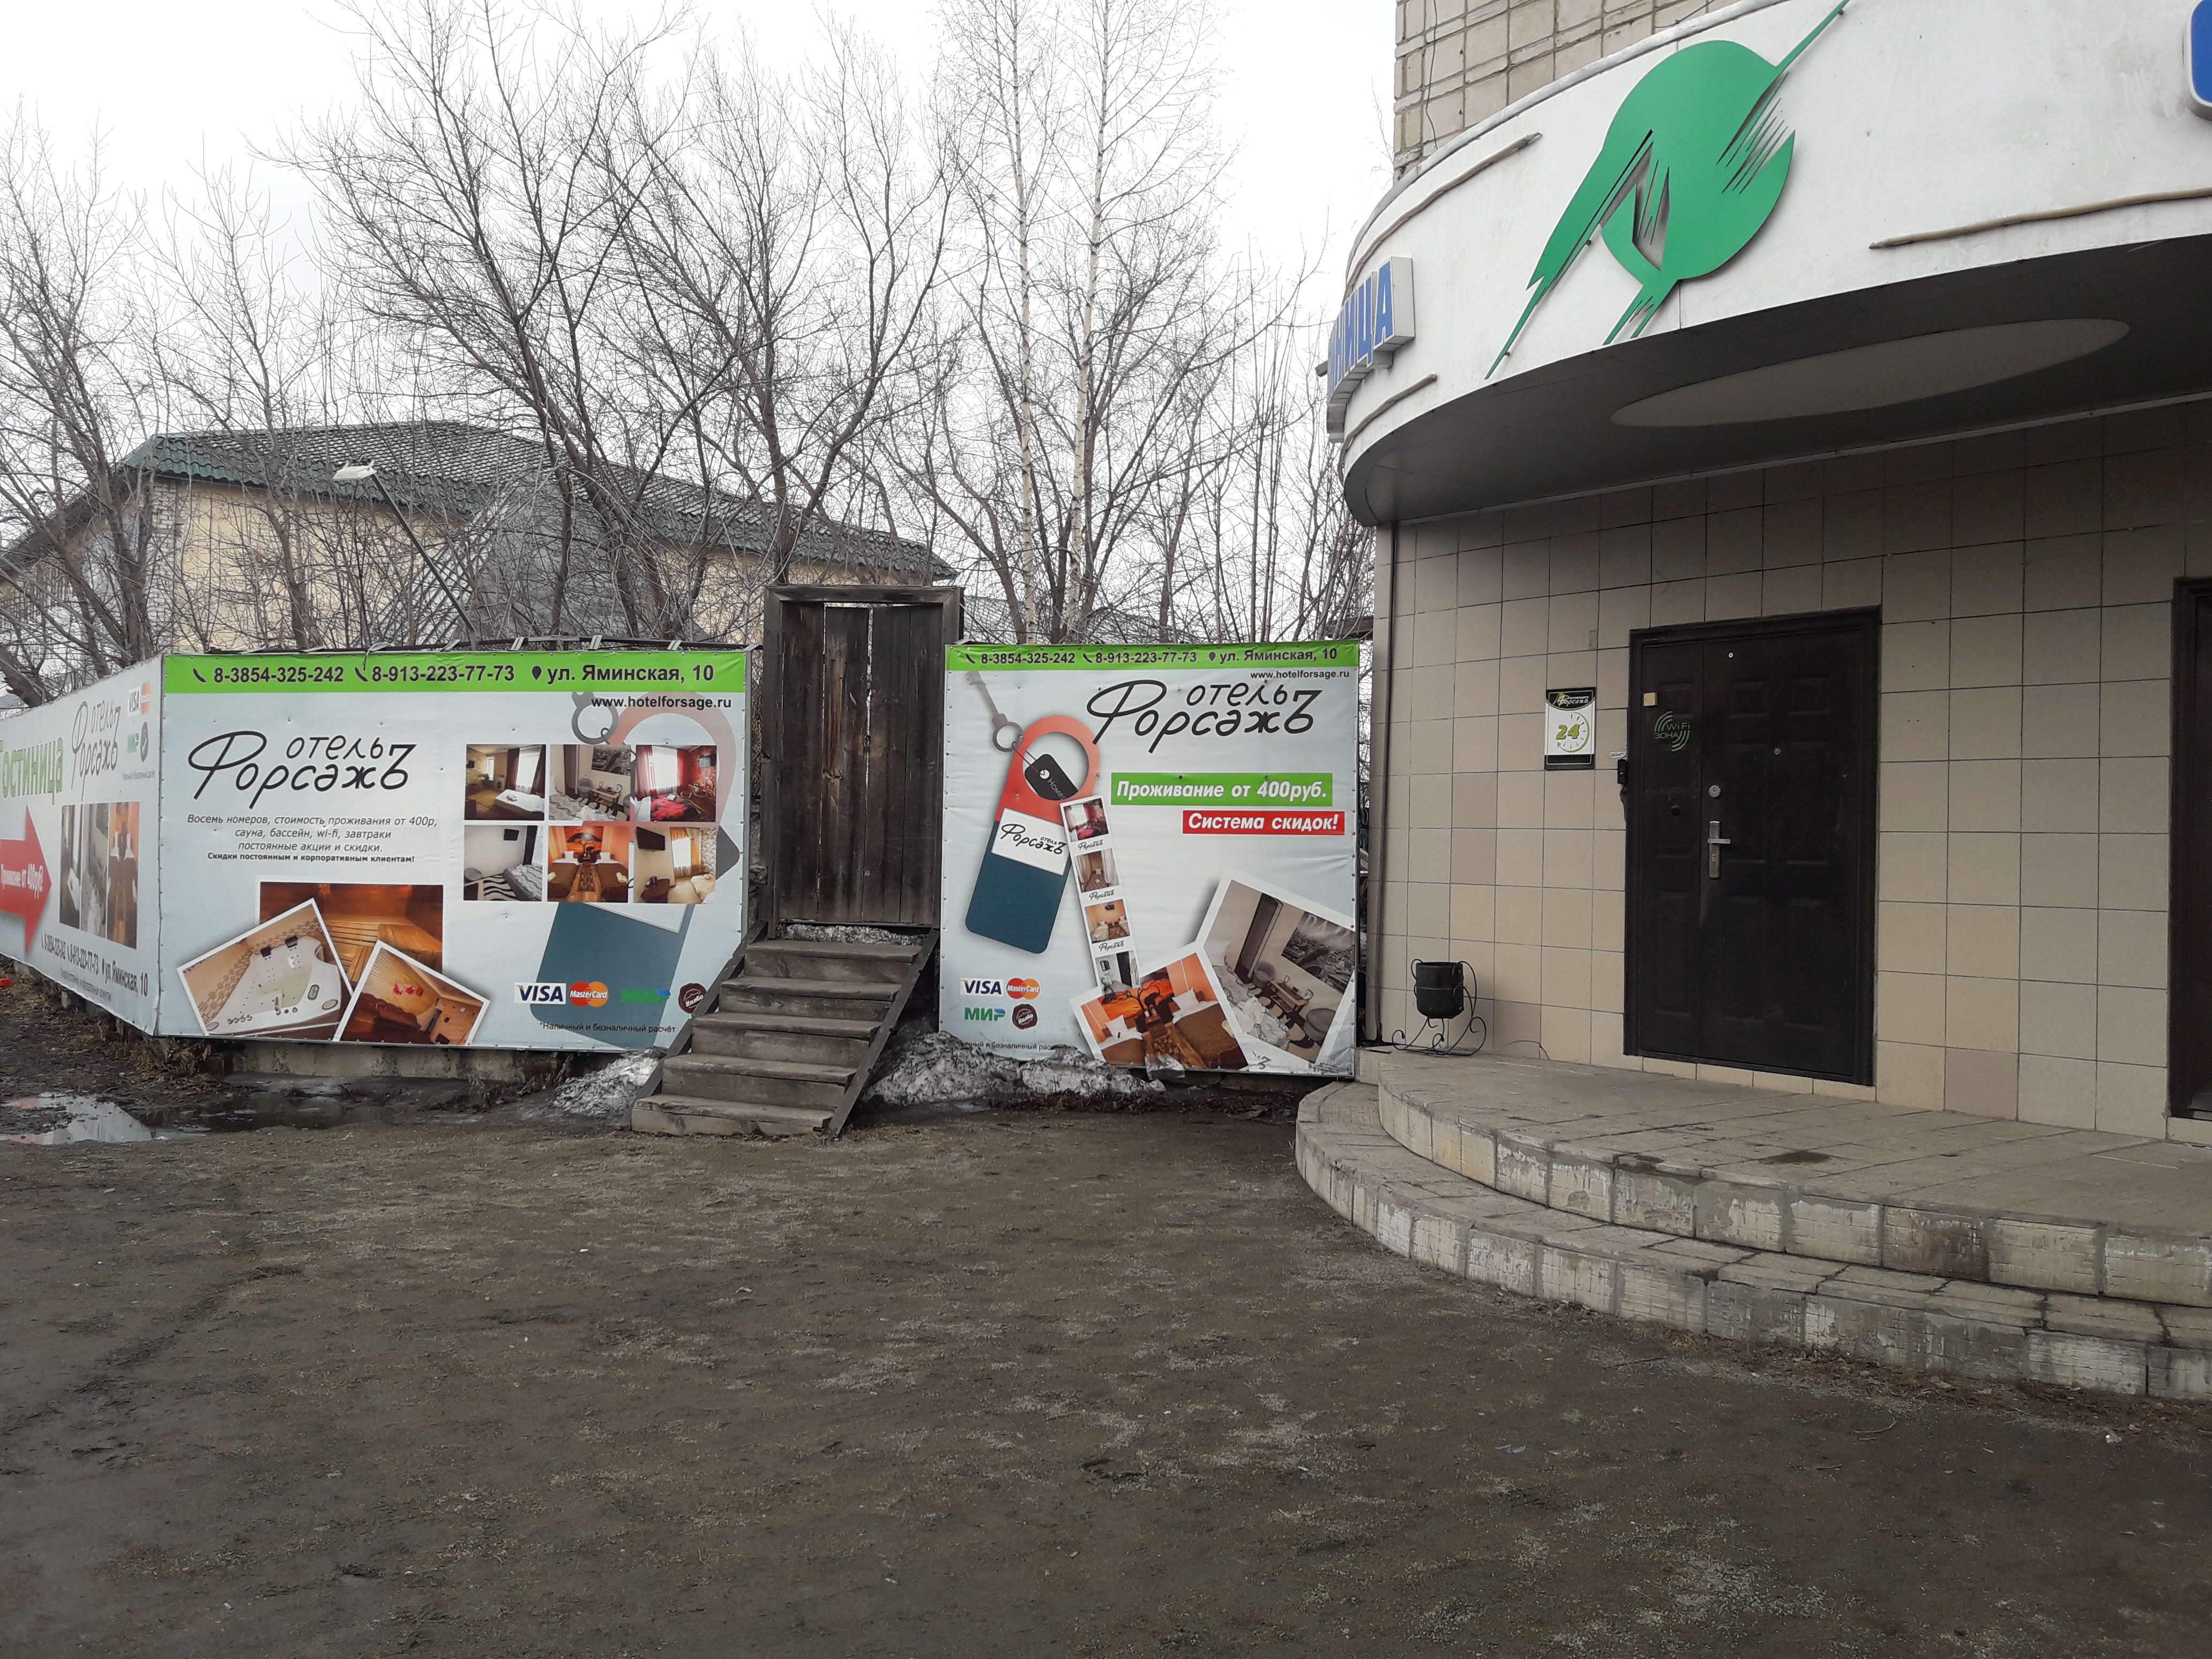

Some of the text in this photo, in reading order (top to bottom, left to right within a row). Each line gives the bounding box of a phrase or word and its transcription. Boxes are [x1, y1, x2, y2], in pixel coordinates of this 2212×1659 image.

[981, 648, 1337, 664] 8-3854-325-242 8-913-223-77-73 ул. Яминская, 10
[214, 664, 714, 685] 8-3854-325-242 8-913-223-77-73 ул. Яминская, 10
[1250, 670, 1349, 680] www.hotelforsage.ru
[1186, 682, 1288, 706] отель
[592, 696, 732, 710] www.hotelforsage.ru
[1556, 724, 1580, 740] 24
[286, 735, 383, 760] отель
[1117, 780, 1326, 802] Проживание от 400руб.
[188, 814, 223, 823] Восемь
[226, 816, 271, 825] номеров,
[274, 816, 325, 825] стоимость
[328, 817, 391, 826] проживания
[409, 816, 438, 827] 400р,
[1189, 812, 1339, 832] Система скидок!
[235, 828, 391, 840] сауна, бассейн, wi-fi, завтраки
[238, 842, 297, 850] постоянные
[300, 843, 331, 851] акции
[344, 844, 383, 853] скидки.
[207, 852, 237, 860] Скидки
[141, 972, 148, 997] 10
[962, 980, 1002, 995] VISA
[516, 985, 563, 1002] VISA
[622, 989, 670, 1004] МИР
[965, 1007, 1006, 1021] МИР
[593, 1023, 646, 1032] безналичный
[648, 1025, 676, 1033] расчёт
